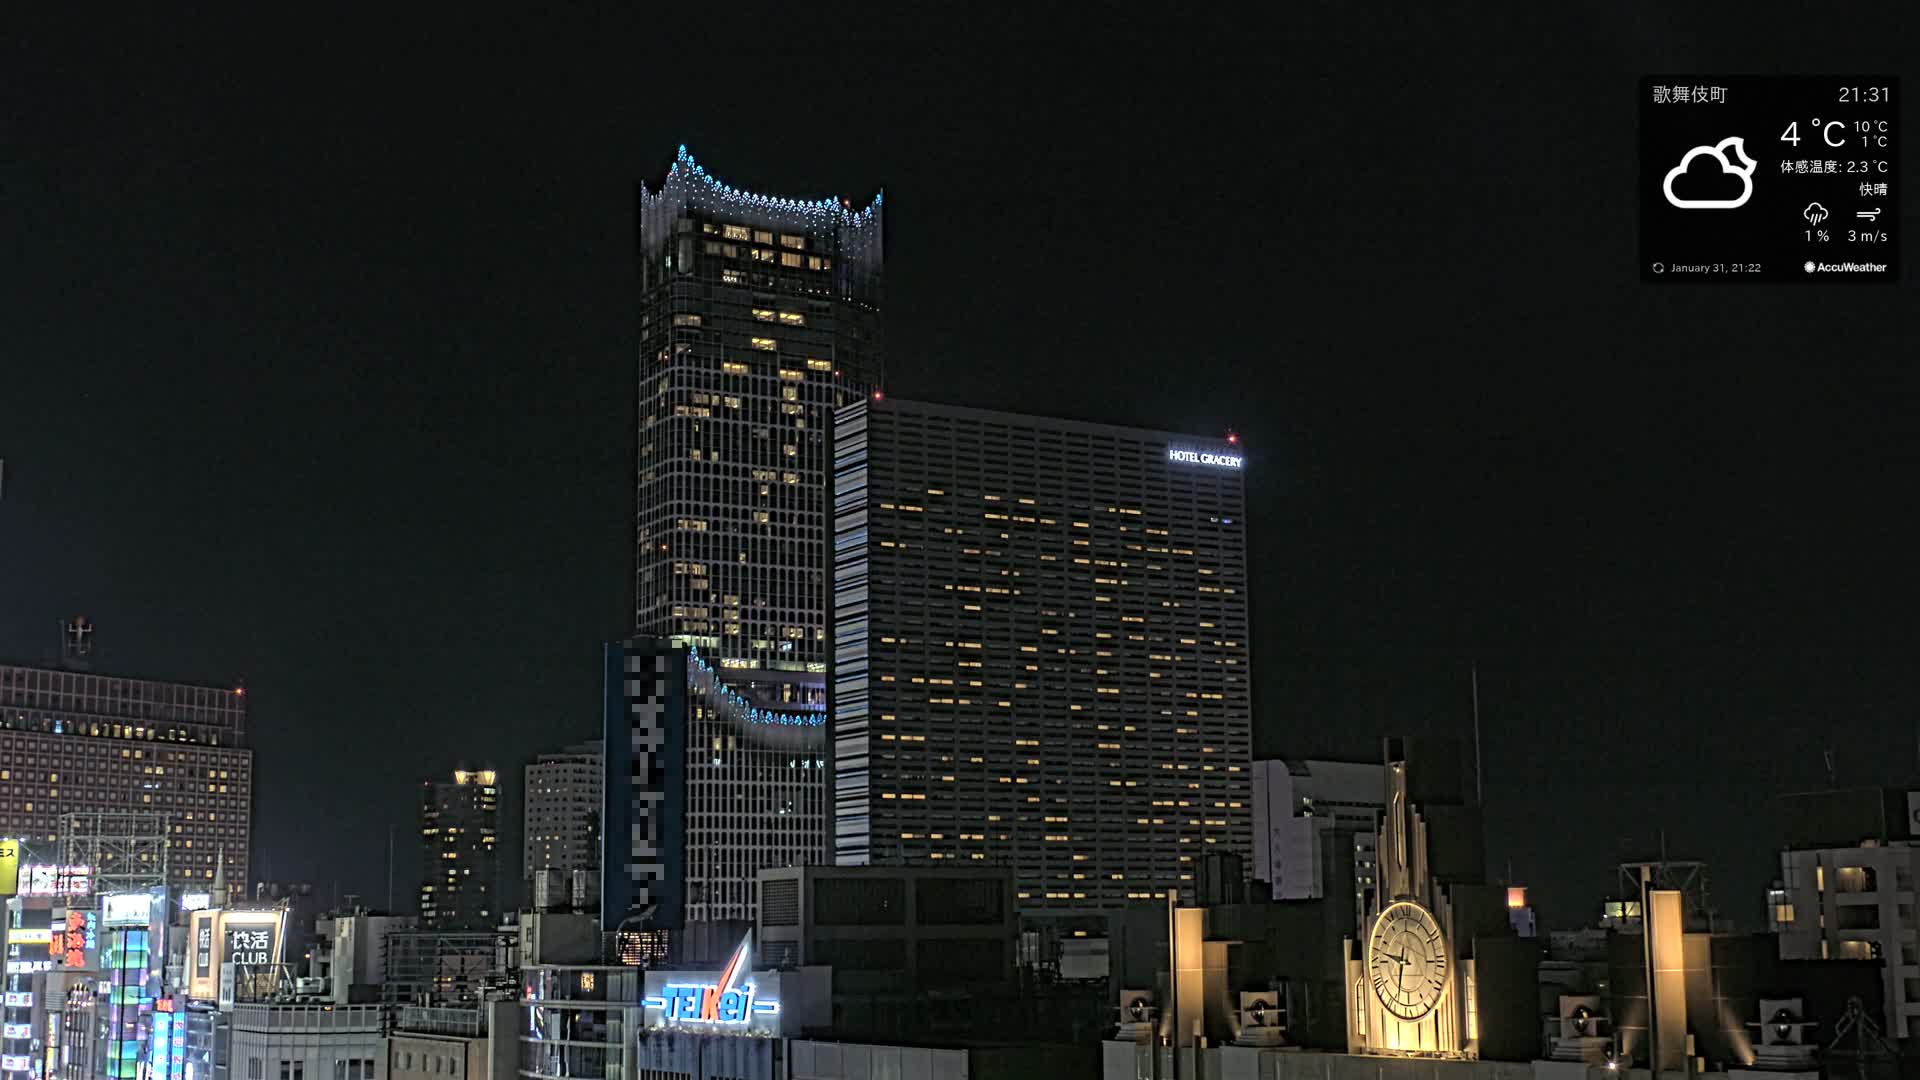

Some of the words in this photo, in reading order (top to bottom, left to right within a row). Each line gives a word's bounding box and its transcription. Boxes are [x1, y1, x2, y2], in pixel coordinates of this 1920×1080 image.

[1169, 449, 1199, 462] HOTEL
[1200, 453, 1242, 468] GRACERY
[231, 930, 270, 950] 快活
[231, 951, 269, 966] CLUB
